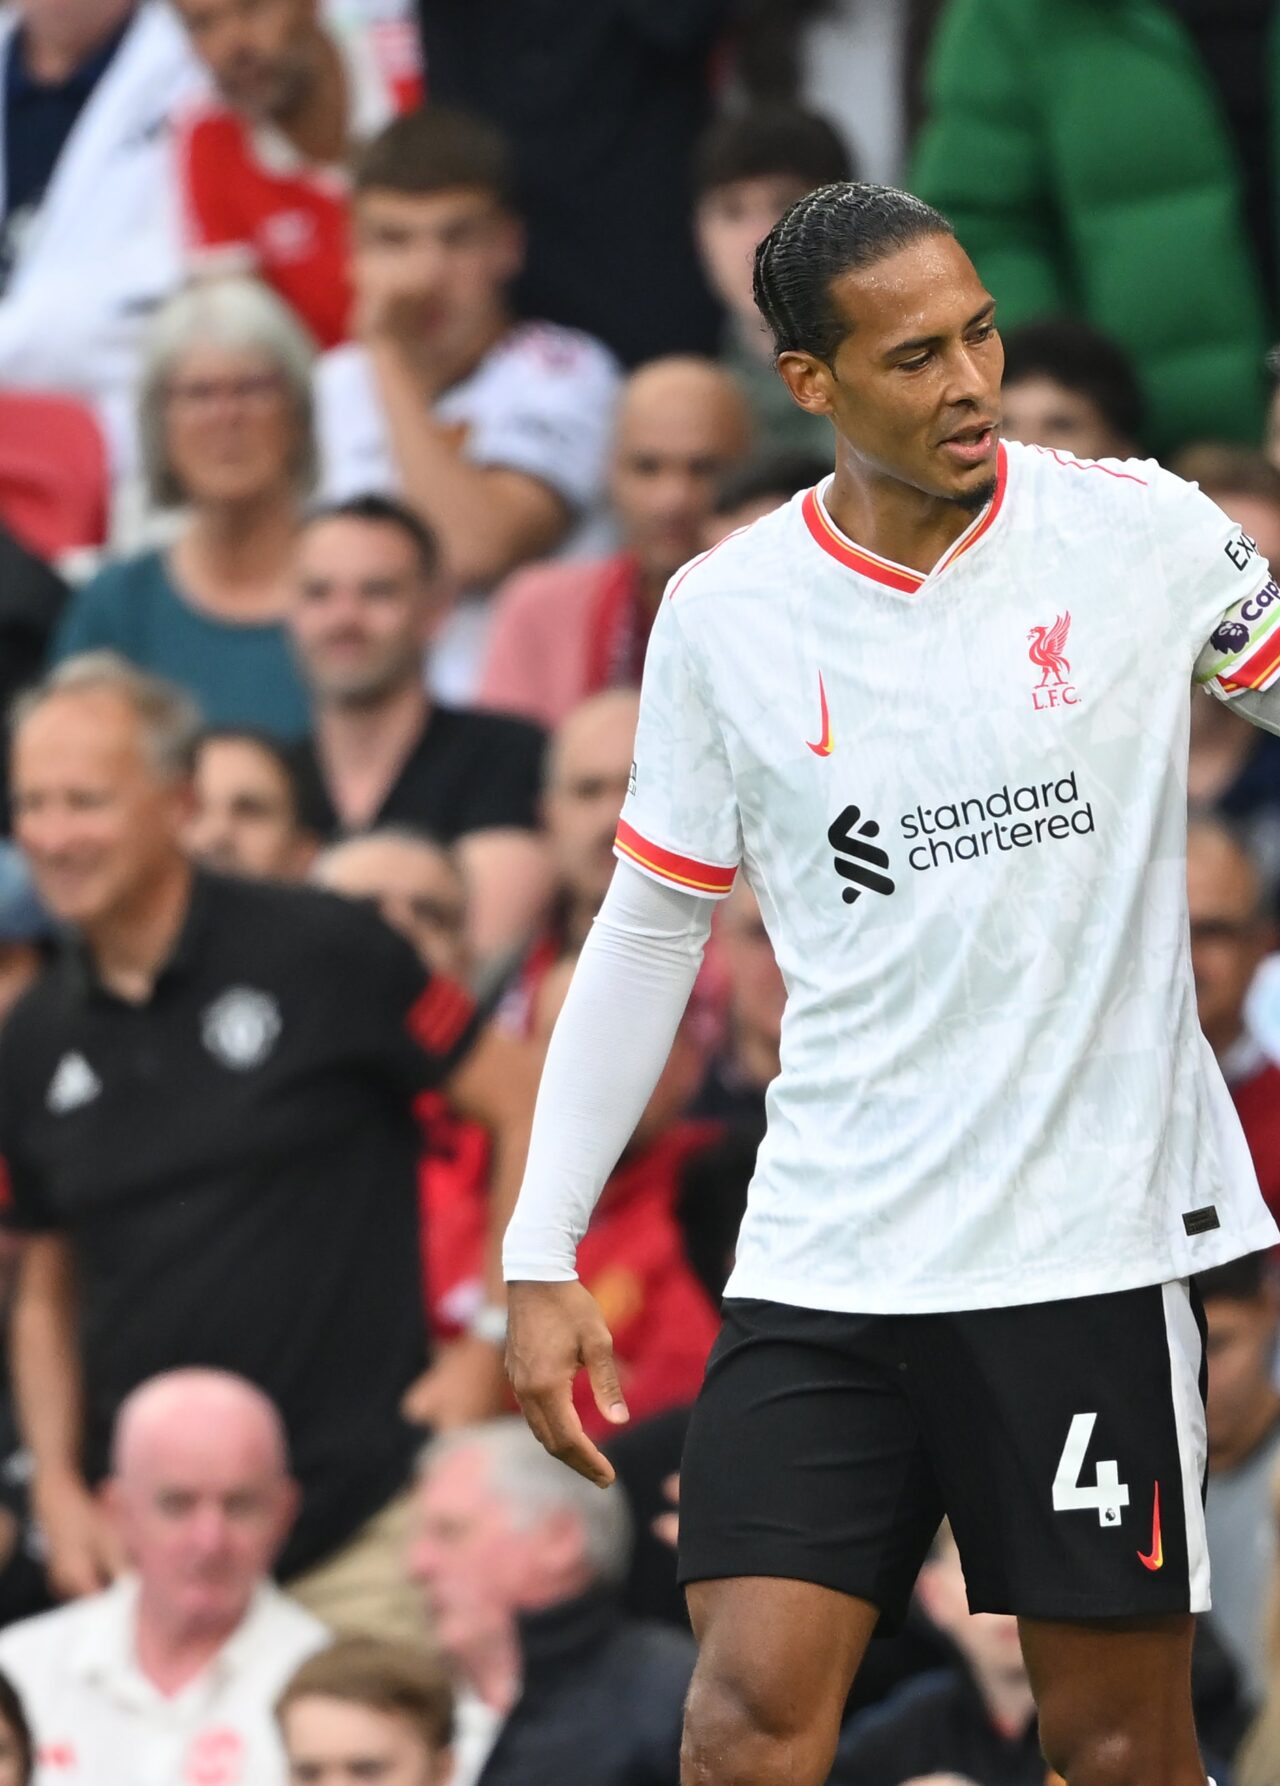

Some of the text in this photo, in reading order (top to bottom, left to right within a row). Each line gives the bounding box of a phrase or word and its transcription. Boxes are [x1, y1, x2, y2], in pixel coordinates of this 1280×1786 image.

[901, 771, 1078, 839] standard
[908, 802, 1095, 870] chartered
[1052, 1412, 1130, 1527] 4
